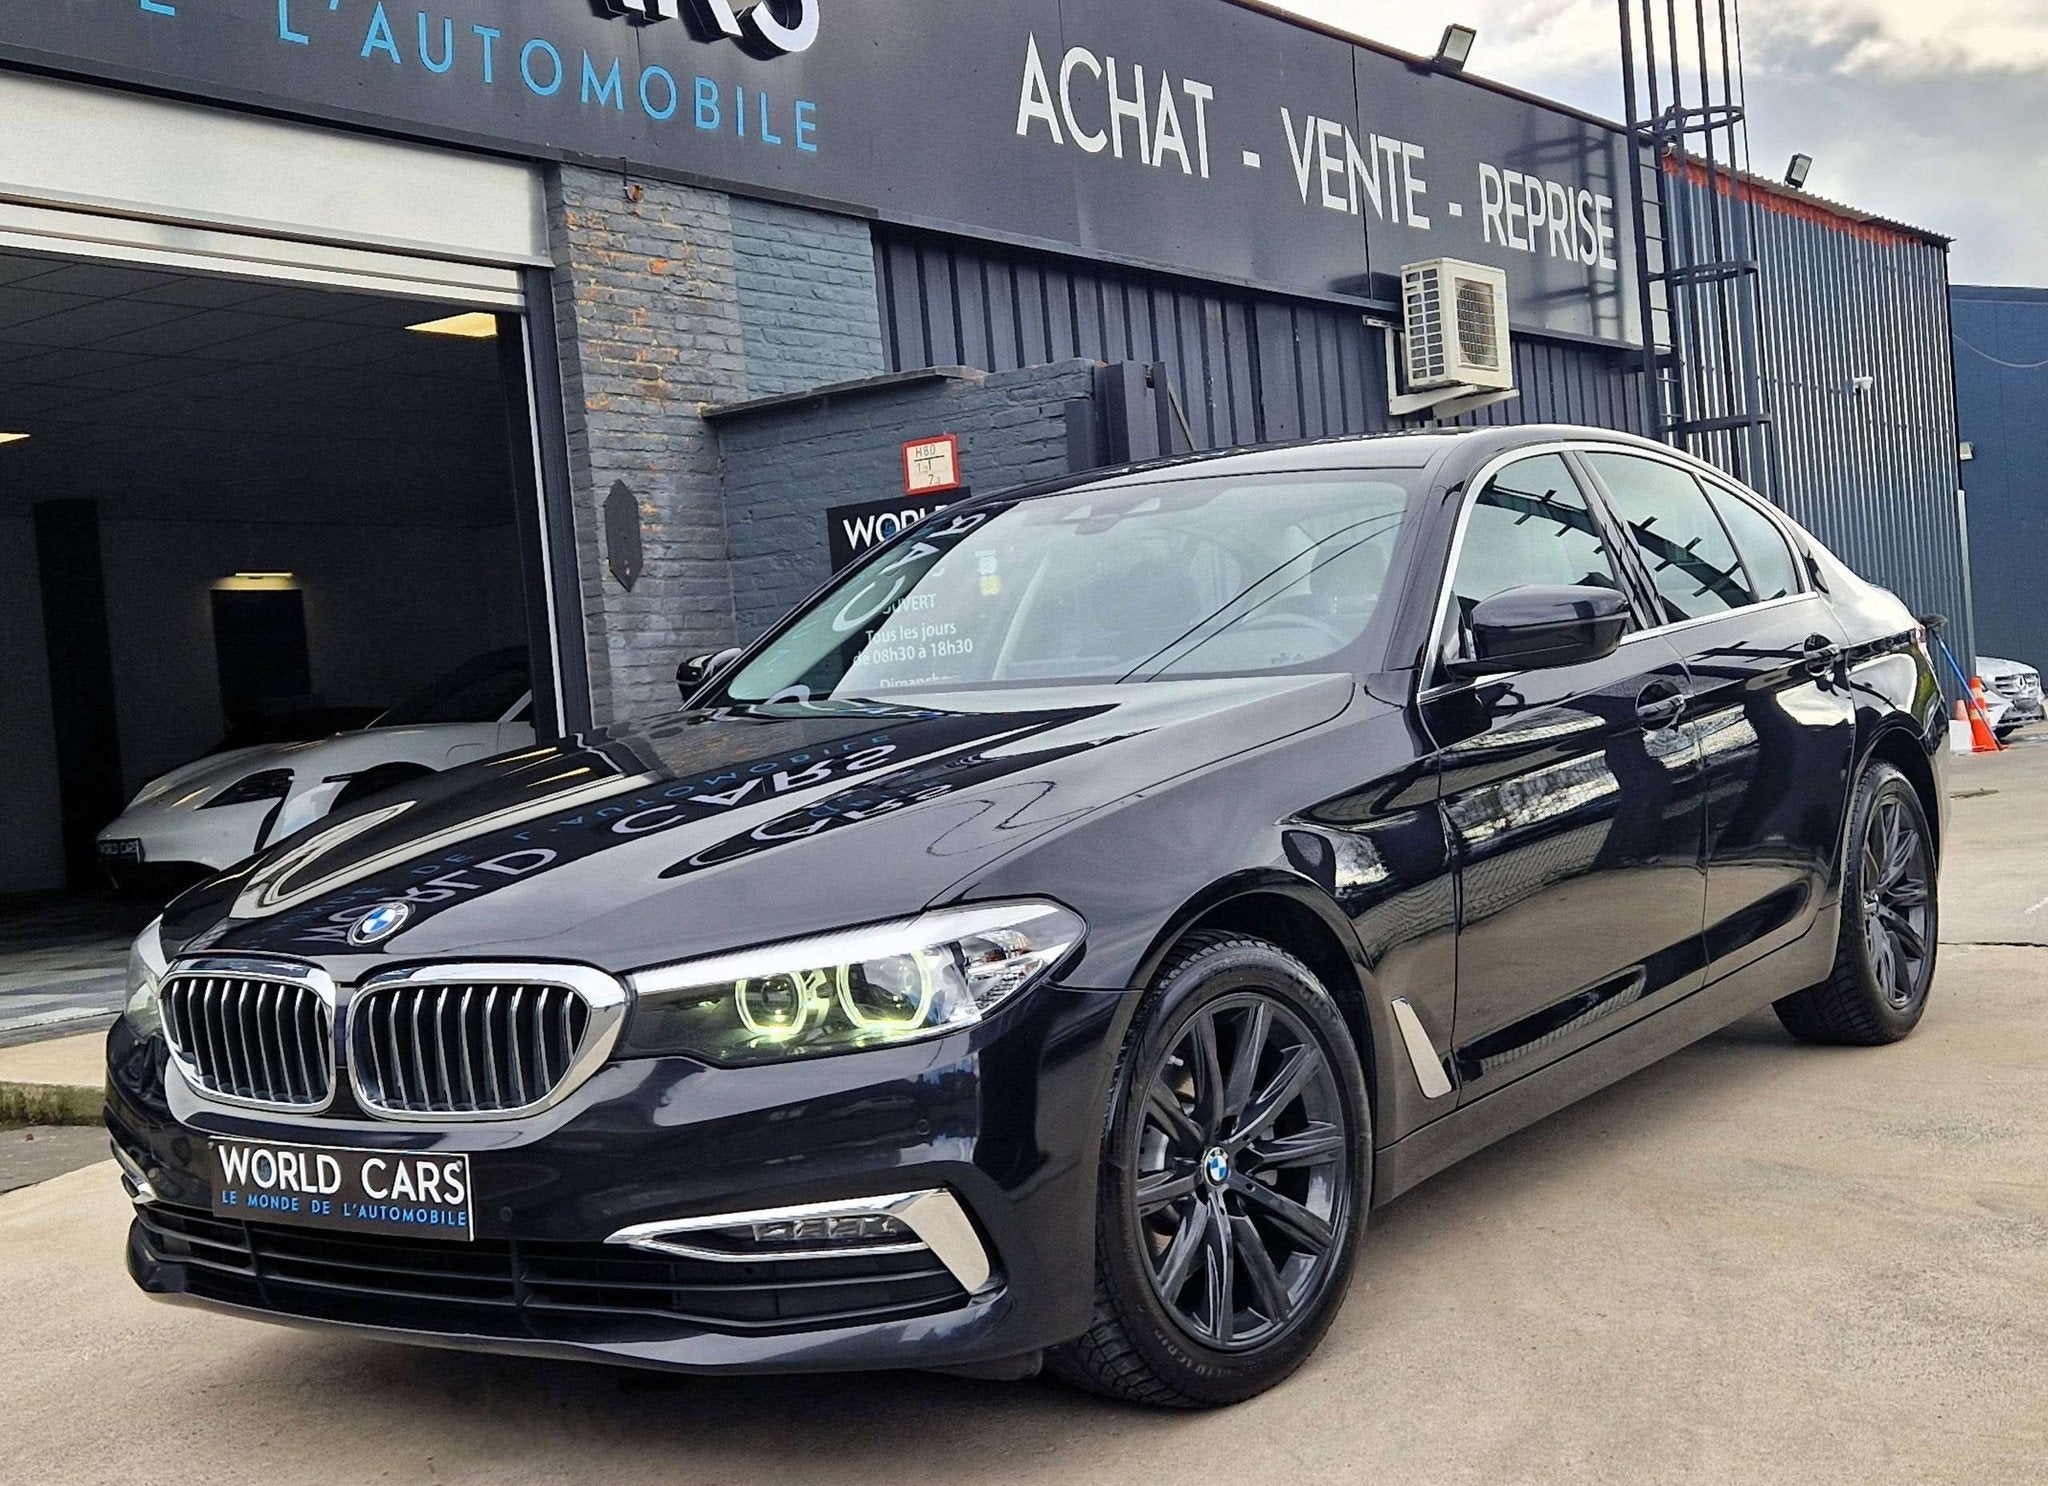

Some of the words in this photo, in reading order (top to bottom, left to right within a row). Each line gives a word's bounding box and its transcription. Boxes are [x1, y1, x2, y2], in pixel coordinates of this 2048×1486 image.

[1016, 31, 1213, 179] ACHAT
[1281, 107, 1431, 230] VENTE
[1479, 162, 1617, 271] REPRISE
[915, 444, 936, 458] H80
[842, 504, 948, 550] WOR
[866, 629, 897, 644] Tous
[899, 625, 918, 639] les
[921, 622, 957, 642] jours
[873, 645, 915, 663] 08h30
[917, 644, 927, 658] à
[931, 638, 973, 657] 18h30
[217, 1144, 342, 1195] WORLD
[361, 1157, 466, 1205] CARS
[221, 1190, 237, 1204] LE
[247, 1193, 300, 1212] MONDE
[311, 1199, 331, 1215] DE
[343, 1204, 468, 1227] L'AUTOMOBILE
